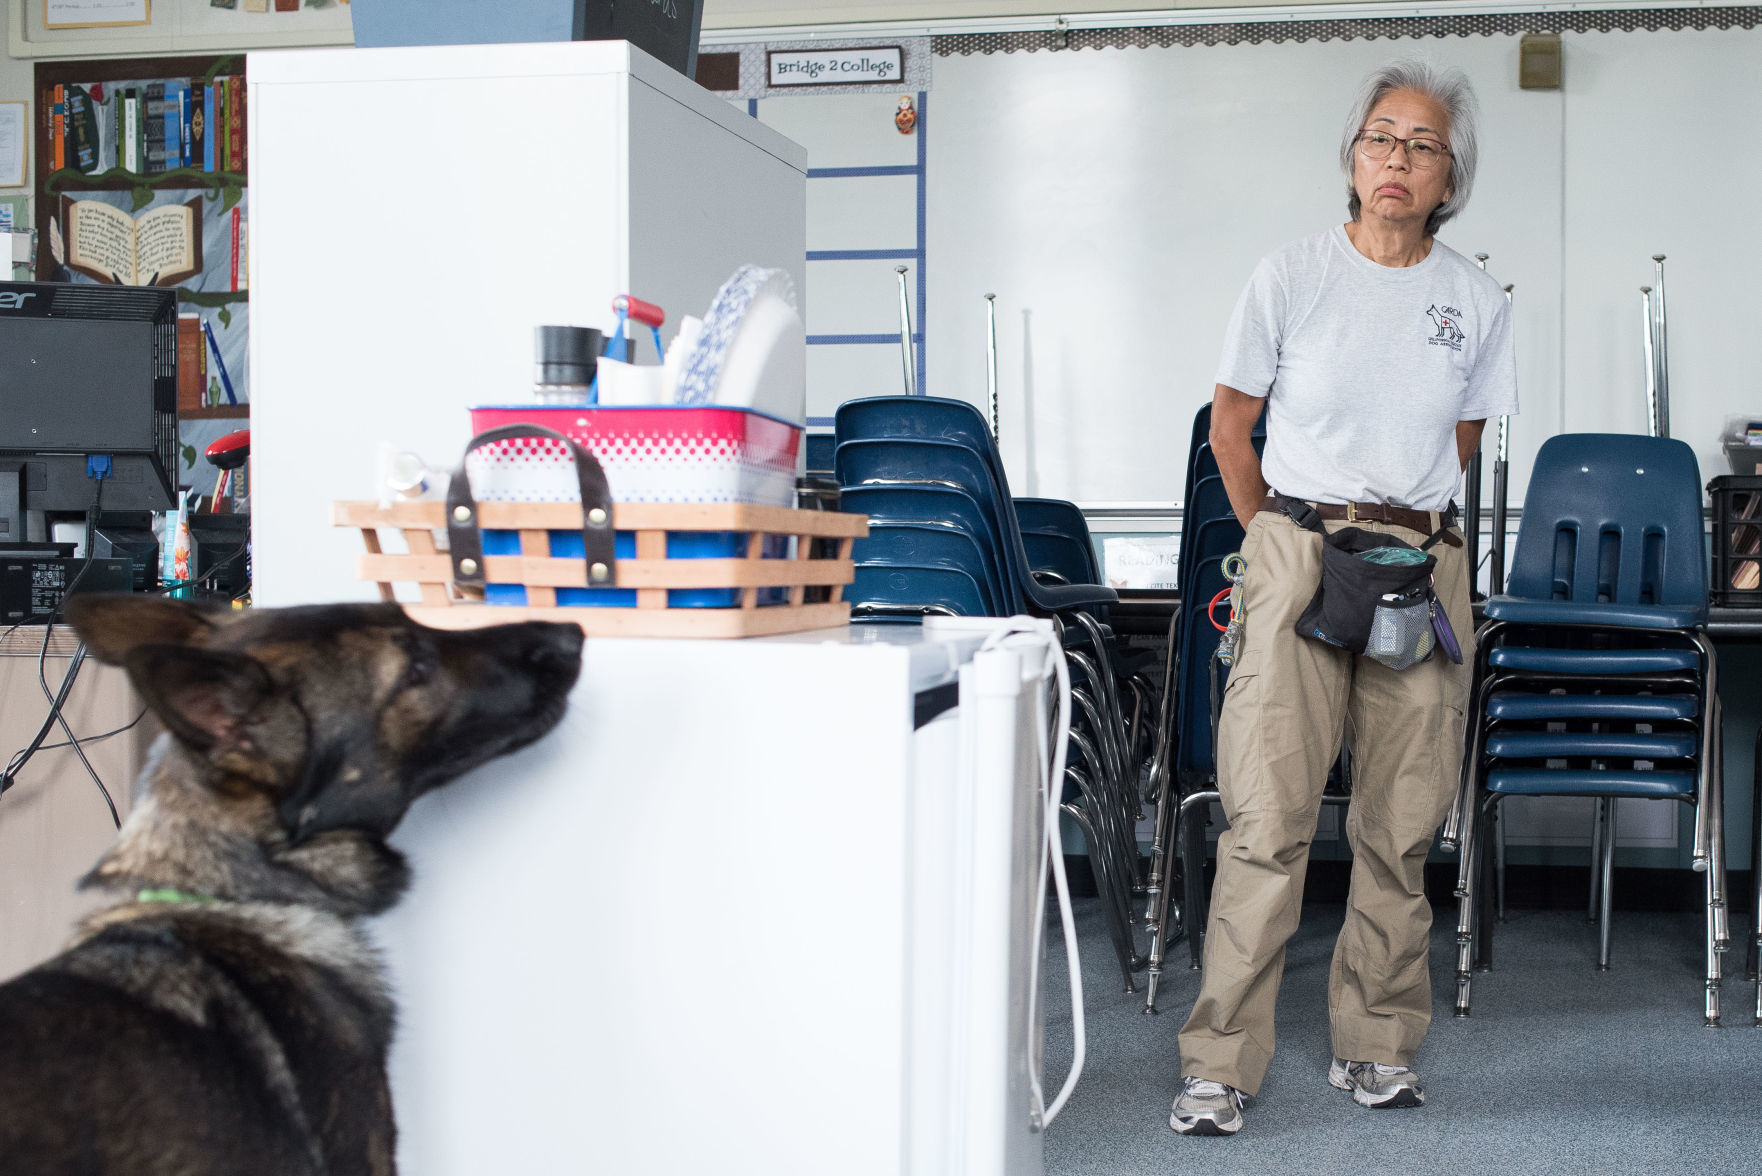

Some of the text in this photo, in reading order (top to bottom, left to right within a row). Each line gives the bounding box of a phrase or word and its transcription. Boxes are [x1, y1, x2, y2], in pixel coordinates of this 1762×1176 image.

[777, 58, 894, 78] Bridge 2 College
